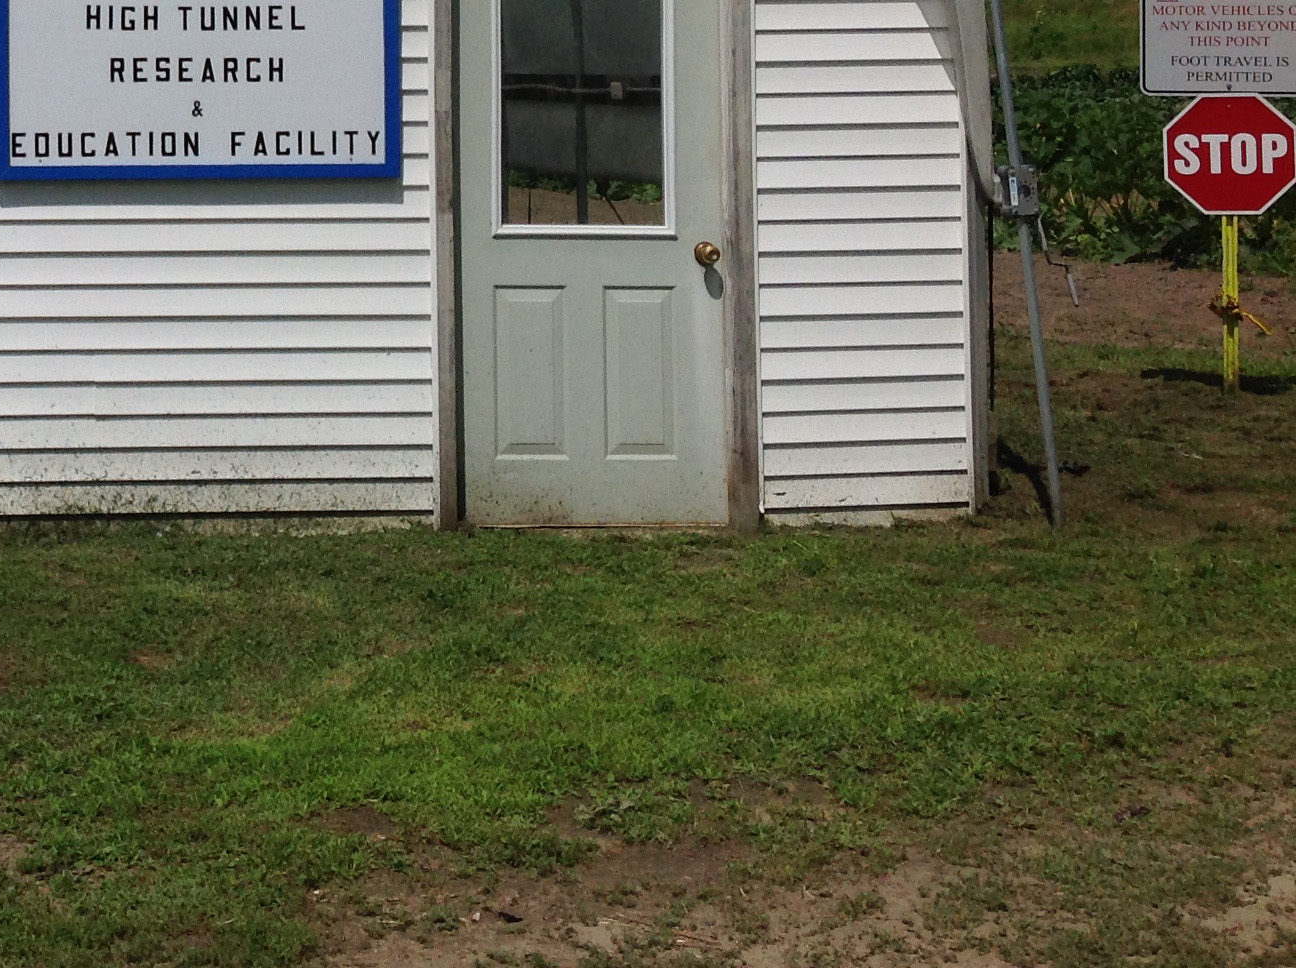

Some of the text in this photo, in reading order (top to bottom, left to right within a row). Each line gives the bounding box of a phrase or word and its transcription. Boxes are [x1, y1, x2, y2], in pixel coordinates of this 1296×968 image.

[1153, 5, 1205, 15] MOTOR
[1210, 5, 1284, 15] VEHICLES
[86, 5, 306, 31] HIGH TUNNEL
[1159, 21, 1191, 31] ANY
[1195, 21, 1232, 31] KIND
[1189, 36, 1270, 46] THIS POINT
[1171, 56, 1289, 67] FOOT TRAVEL IS
[110, 58, 285, 83] RESEARCH
[1187, 72, 1272, 82] PERMITTED
[191, 101, 203, 117] &
[11, 131, 380, 157] EDUCATION FACILITY
[1174, 133, 1287, 175] STOP
